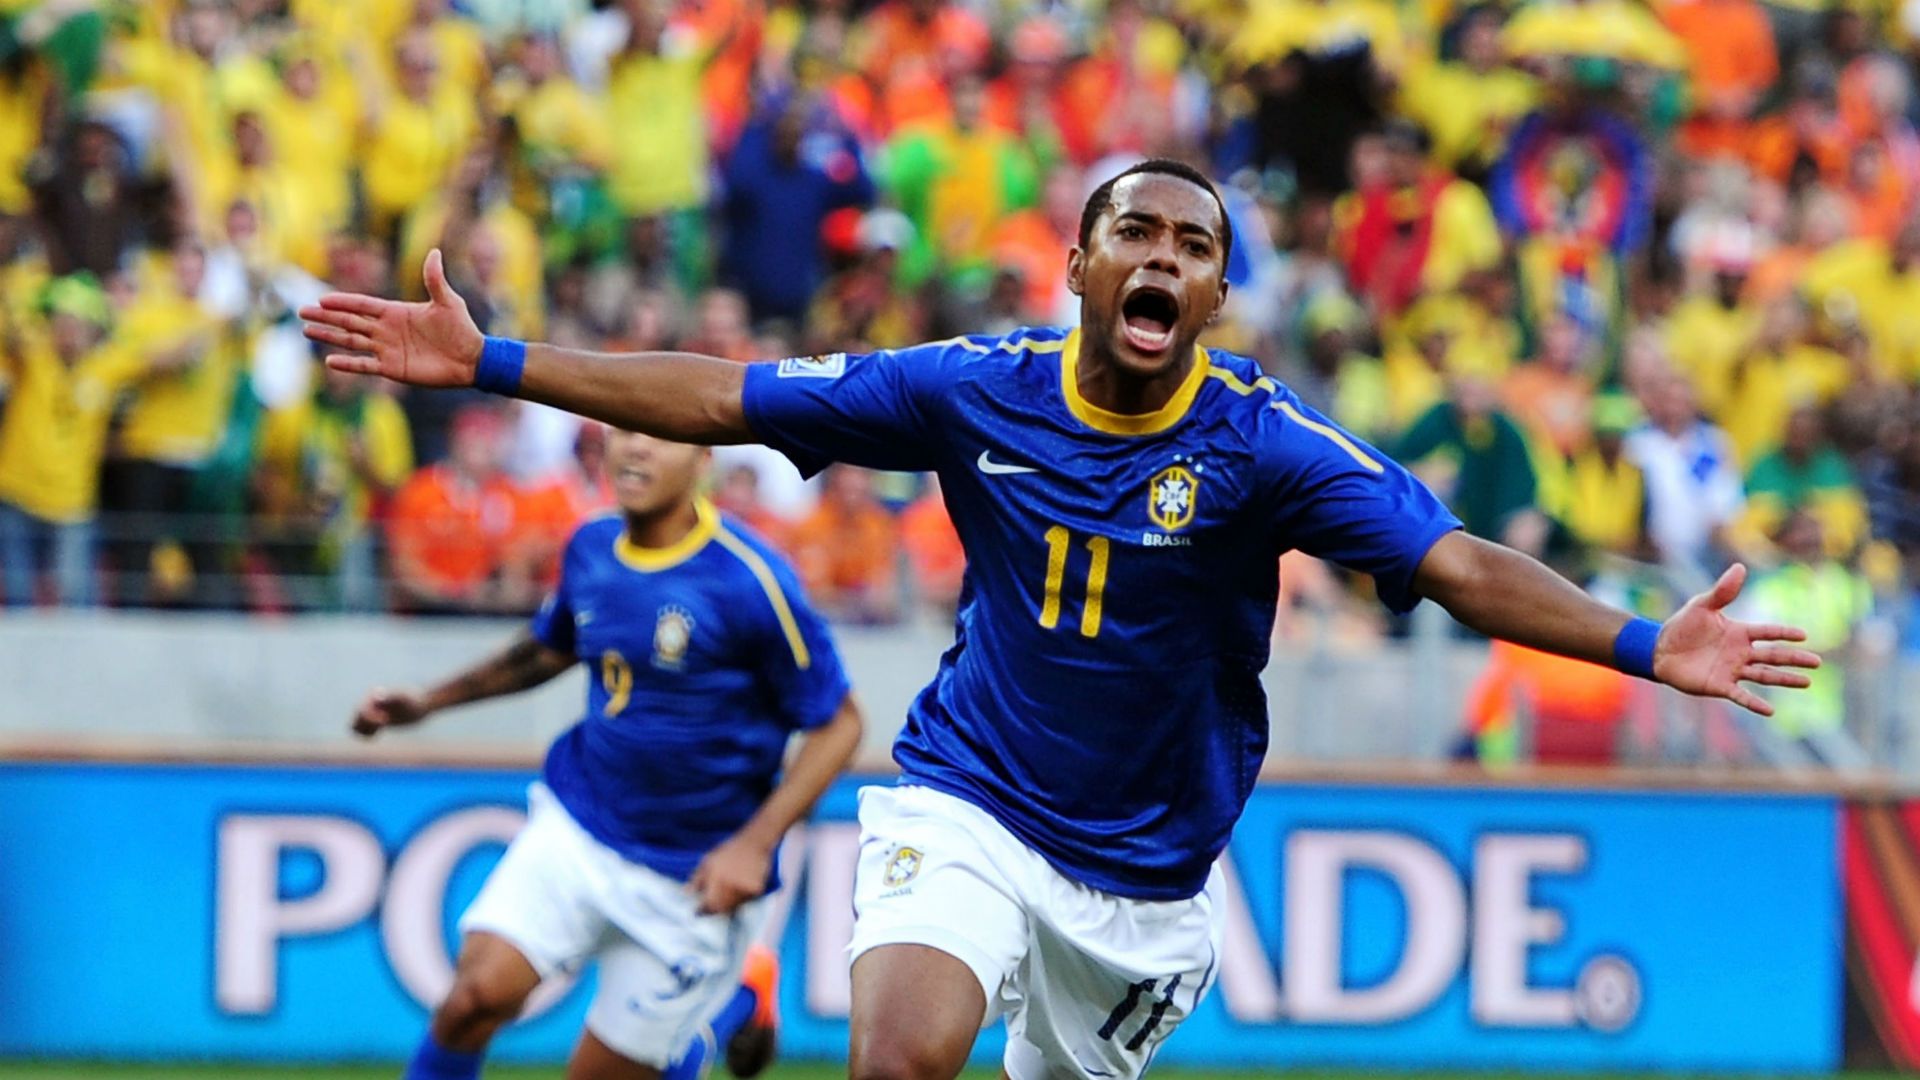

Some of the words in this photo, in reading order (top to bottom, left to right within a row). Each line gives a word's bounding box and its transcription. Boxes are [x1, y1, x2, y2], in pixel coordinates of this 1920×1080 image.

[1142, 532, 1192, 546] BRASIL
[1038, 525, 1109, 638] 11
[602, 649, 633, 718] 9
[1097, 974, 1182, 1051] 11
